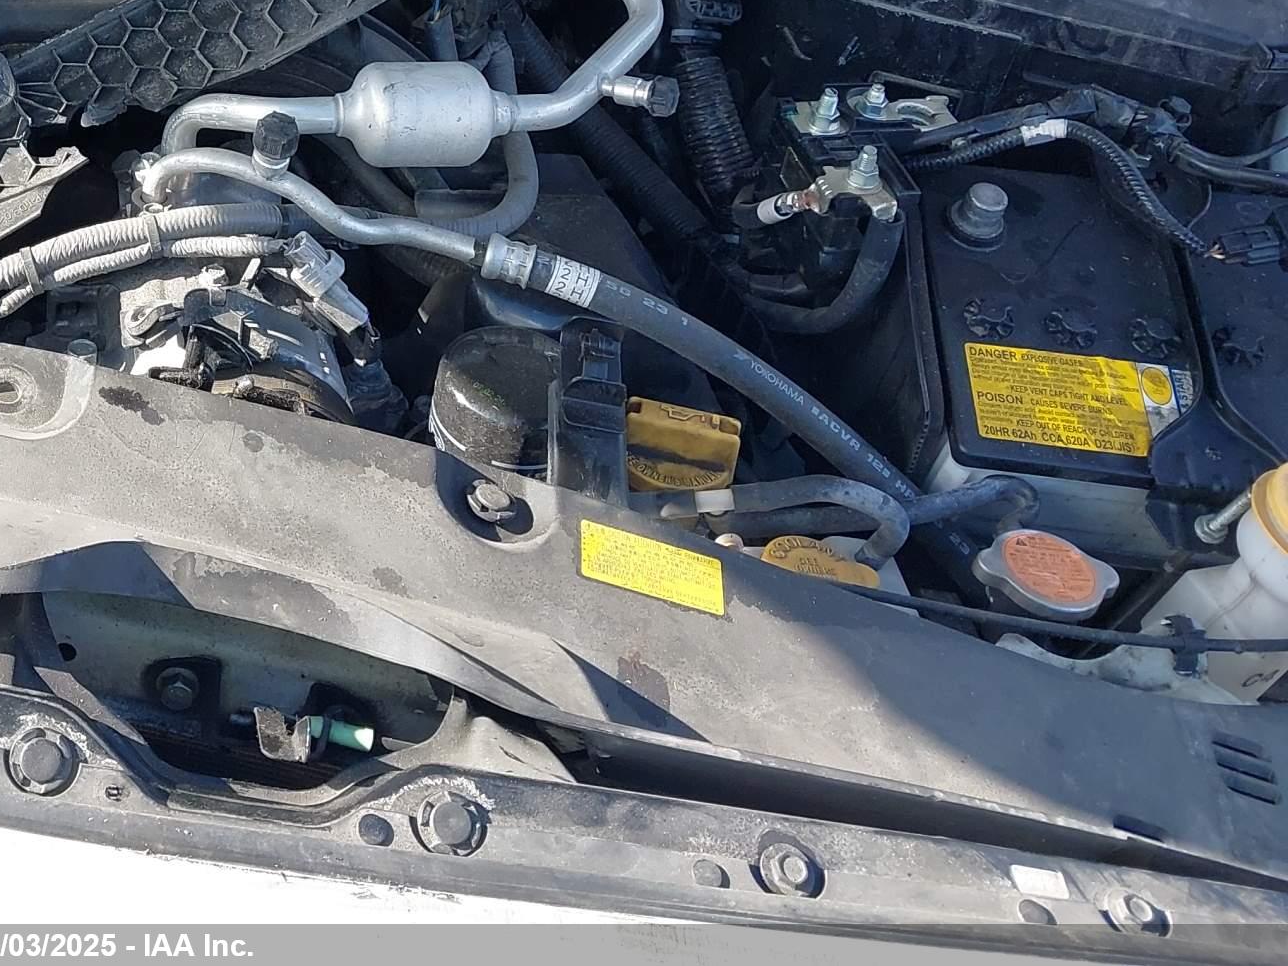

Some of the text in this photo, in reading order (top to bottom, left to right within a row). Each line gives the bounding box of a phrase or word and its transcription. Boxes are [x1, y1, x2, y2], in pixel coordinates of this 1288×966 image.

[968, 346, 1018, 361] DANGER
[749, 360, 804, 406] YOKOHAMA
[976, 391, 1024, 405] POISON
[1030, 398, 1057, 409] CAUSES
[1060, 401, 1086, 412] SEVERE
[1010, 385, 1028, 394] KEEP
[1029, 387, 1048, 395] VENT
[1048, 389, 1068, 399] CAPS
[1069, 391, 1089, 401] TIGHT
[1106, 395, 1128, 406] LEVEL
[983, 424, 1011, 438] 20HR
[1015, 418, 1135, 441] KEEP OUT OF REACH OF CHILDREN
